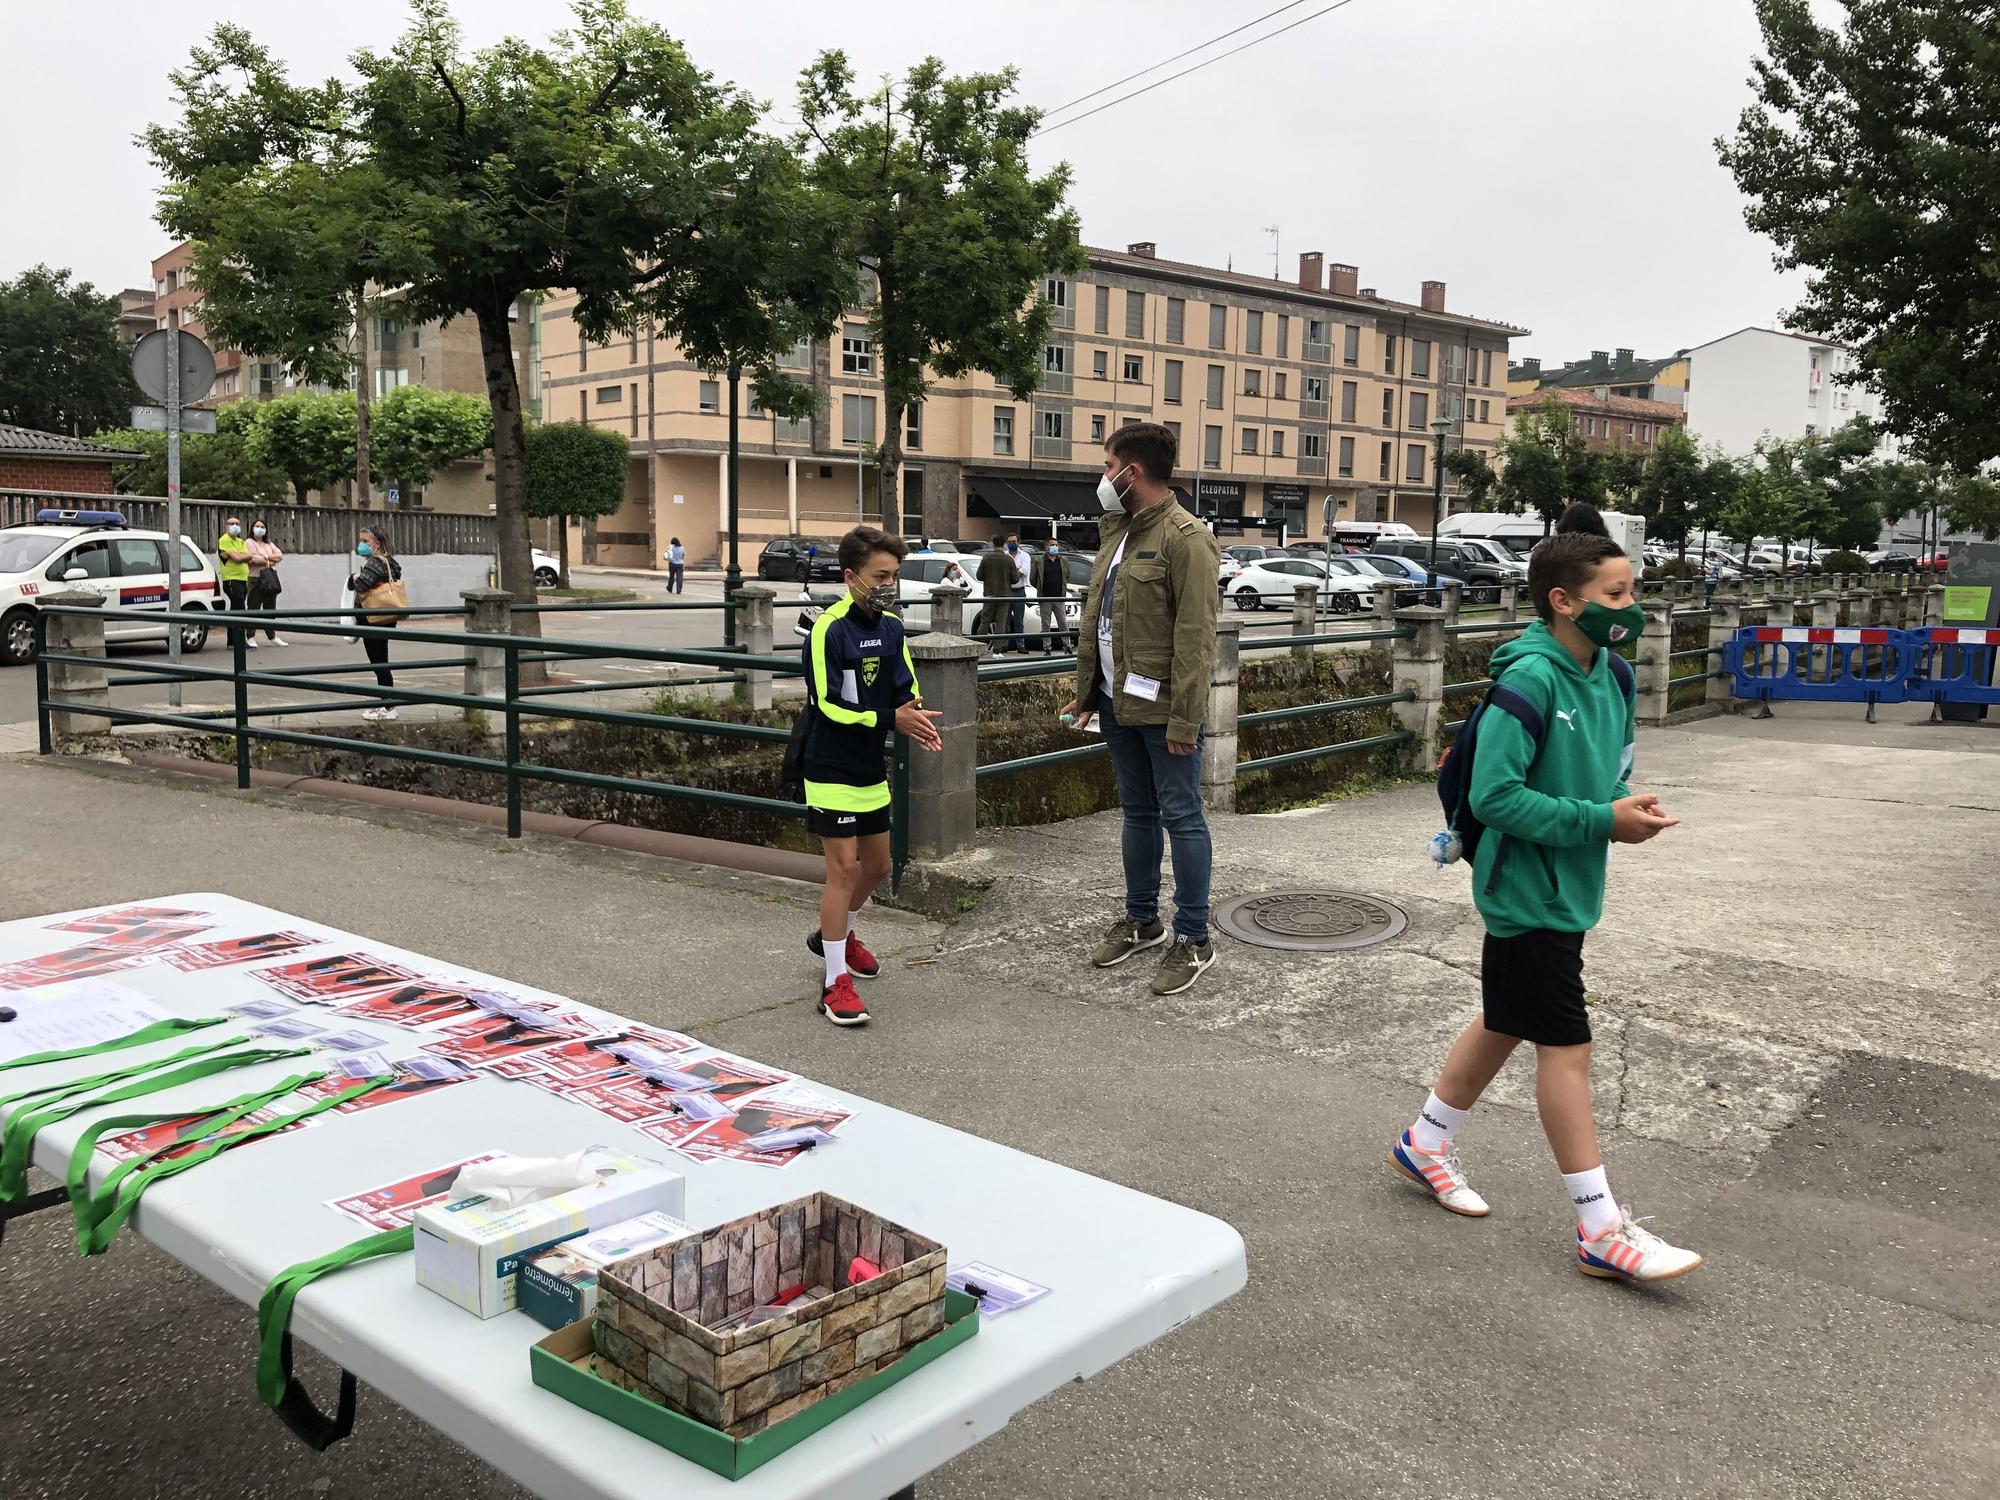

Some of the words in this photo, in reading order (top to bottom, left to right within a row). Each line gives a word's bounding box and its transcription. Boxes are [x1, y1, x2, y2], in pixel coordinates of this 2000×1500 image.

[1200, 484, 1239, 496] CLEOPATRA
[20, 583, 39, 595] 112
[859, 638, 882, 648] LEGEA
[524, 1265, 574, 1303] Termómetro
